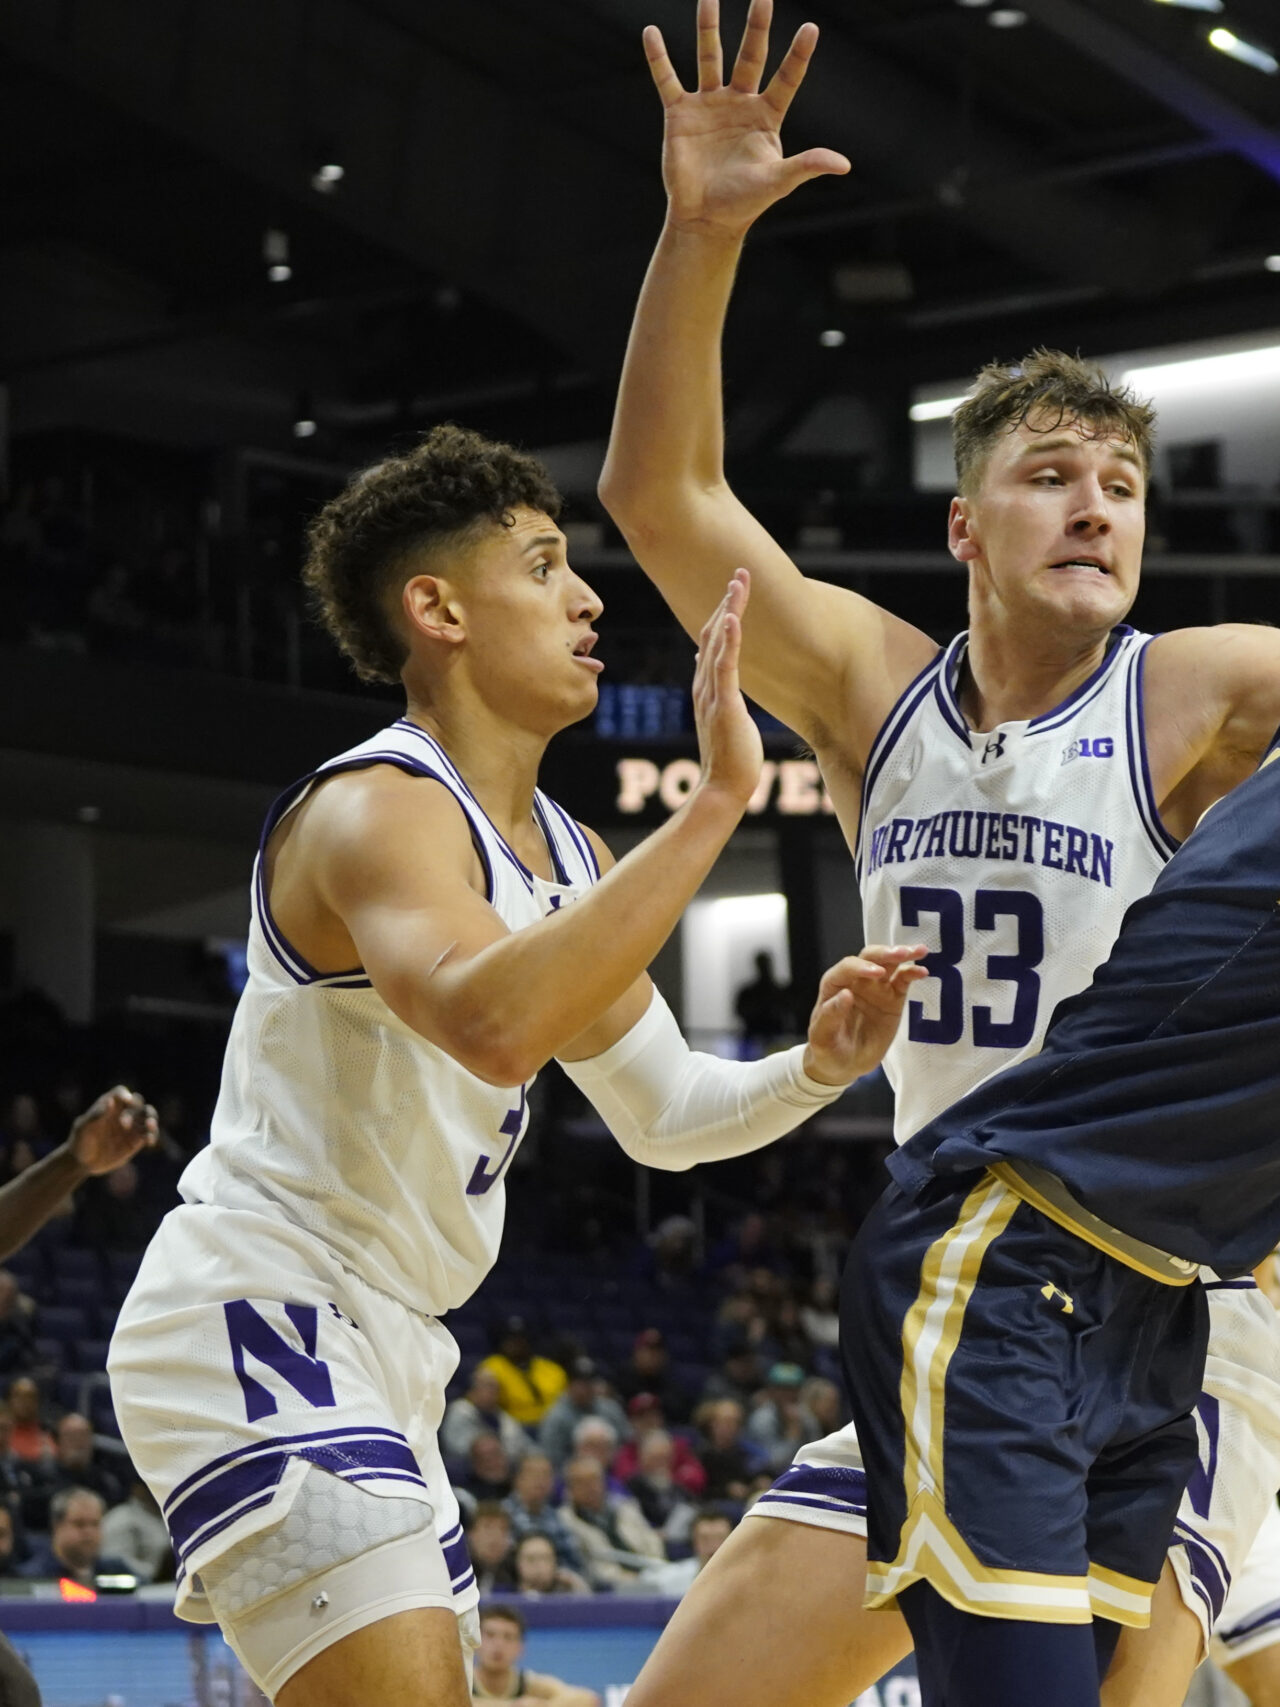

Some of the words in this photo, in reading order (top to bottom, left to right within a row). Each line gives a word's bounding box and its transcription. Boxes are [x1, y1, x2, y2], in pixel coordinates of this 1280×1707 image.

[868, 811, 1114, 888] NORTHWESTERN
[900, 886, 1045, 1049] 33
[223, 1299, 336, 1423] N
